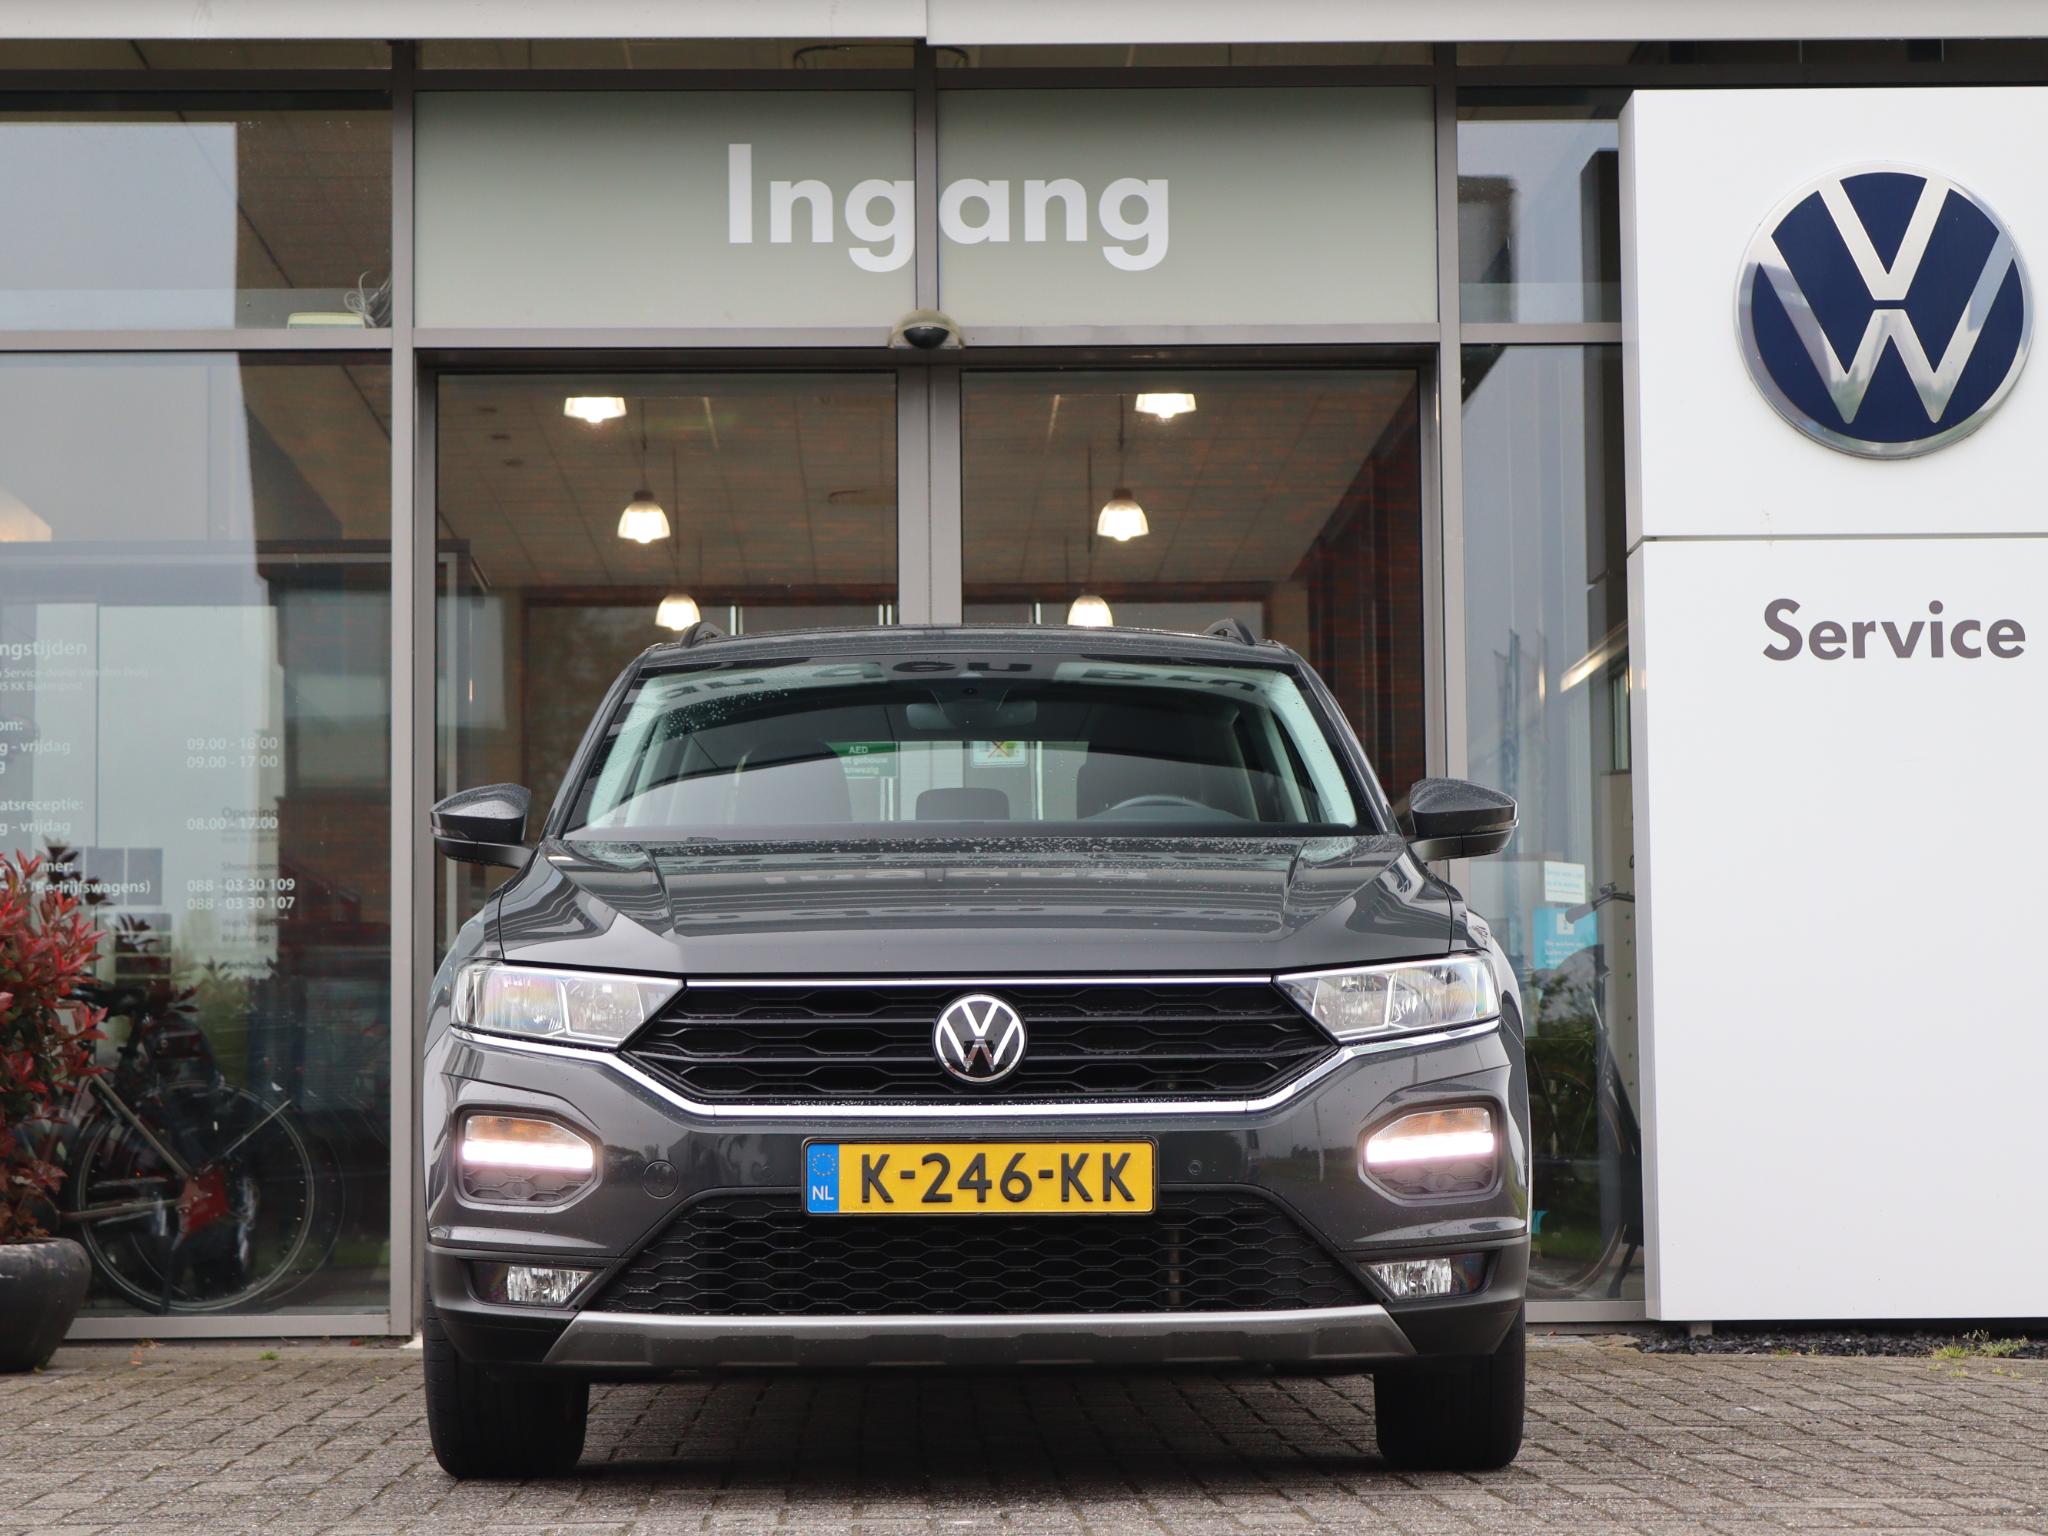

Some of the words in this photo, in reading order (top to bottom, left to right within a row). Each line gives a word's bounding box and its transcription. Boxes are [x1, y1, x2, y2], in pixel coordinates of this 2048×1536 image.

[728, 143, 1169, 272] Ingang
[1762, 598, 2026, 661] Service
[20, 739, 72, 756] vrijdag
[187, 738, 226, 750] 09.00
[240, 737, 279, 749] 1800
[849, 745, 869, 754] AED
[187, 756, 226, 768] 09.00
[240, 756, 279, 767] 1700
[20, 820, 72, 836] vrijdag
[187, 818, 226, 830] 08.00
[240, 817, 279, 829] 17.00
[187, 880, 214, 892] 088
[226, 880, 243, 892] 03
[247, 880, 265, 891] 30
[270, 878, 295, 891] 109
[187, 899, 214, 910] 088
[226, 898, 243, 910] 03
[247, 898, 265, 909] 30
[270, 897, 295, 909] 107
[812, 1185, 834, 1200] NL
[861, 1152, 1136, 1204] K-246-KK
